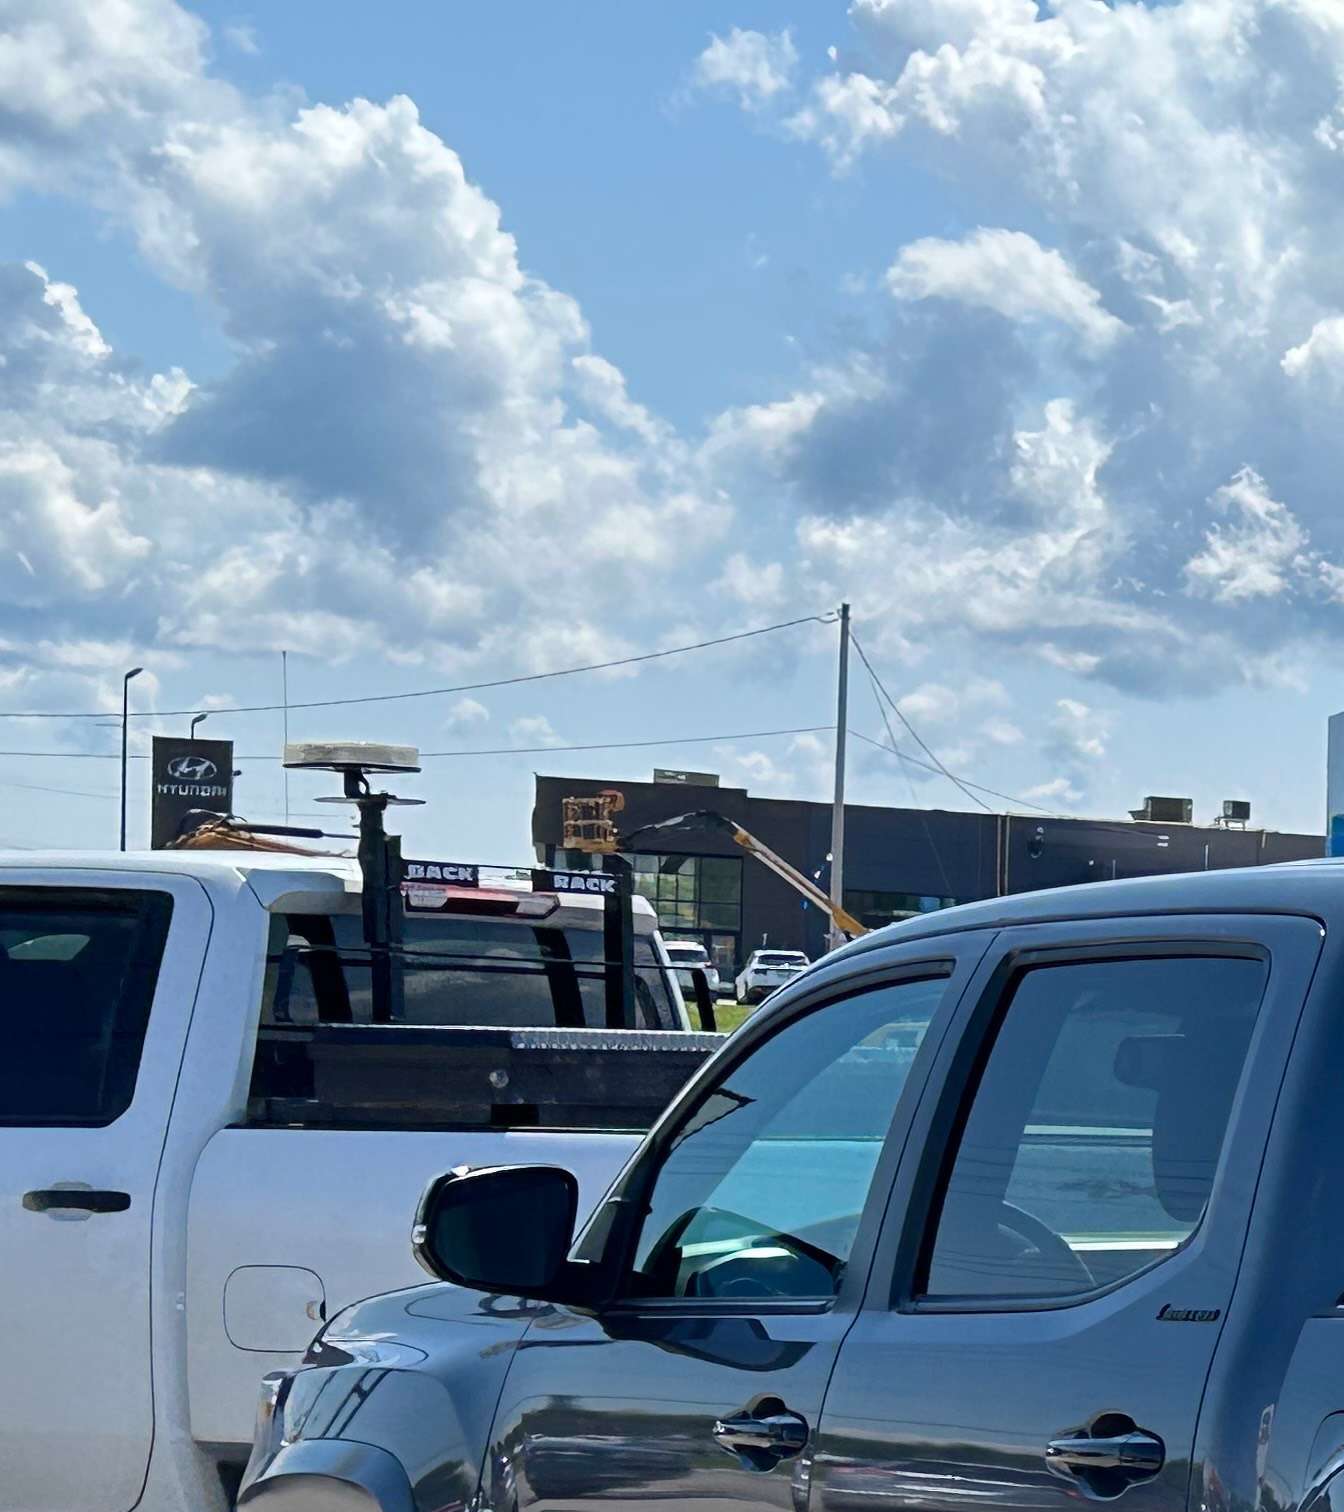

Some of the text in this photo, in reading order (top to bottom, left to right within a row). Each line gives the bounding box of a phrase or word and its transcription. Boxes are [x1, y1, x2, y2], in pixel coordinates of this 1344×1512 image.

[157, 784, 227, 796] HYUNDAI
[405, 864, 616, 892] BACK RACK
